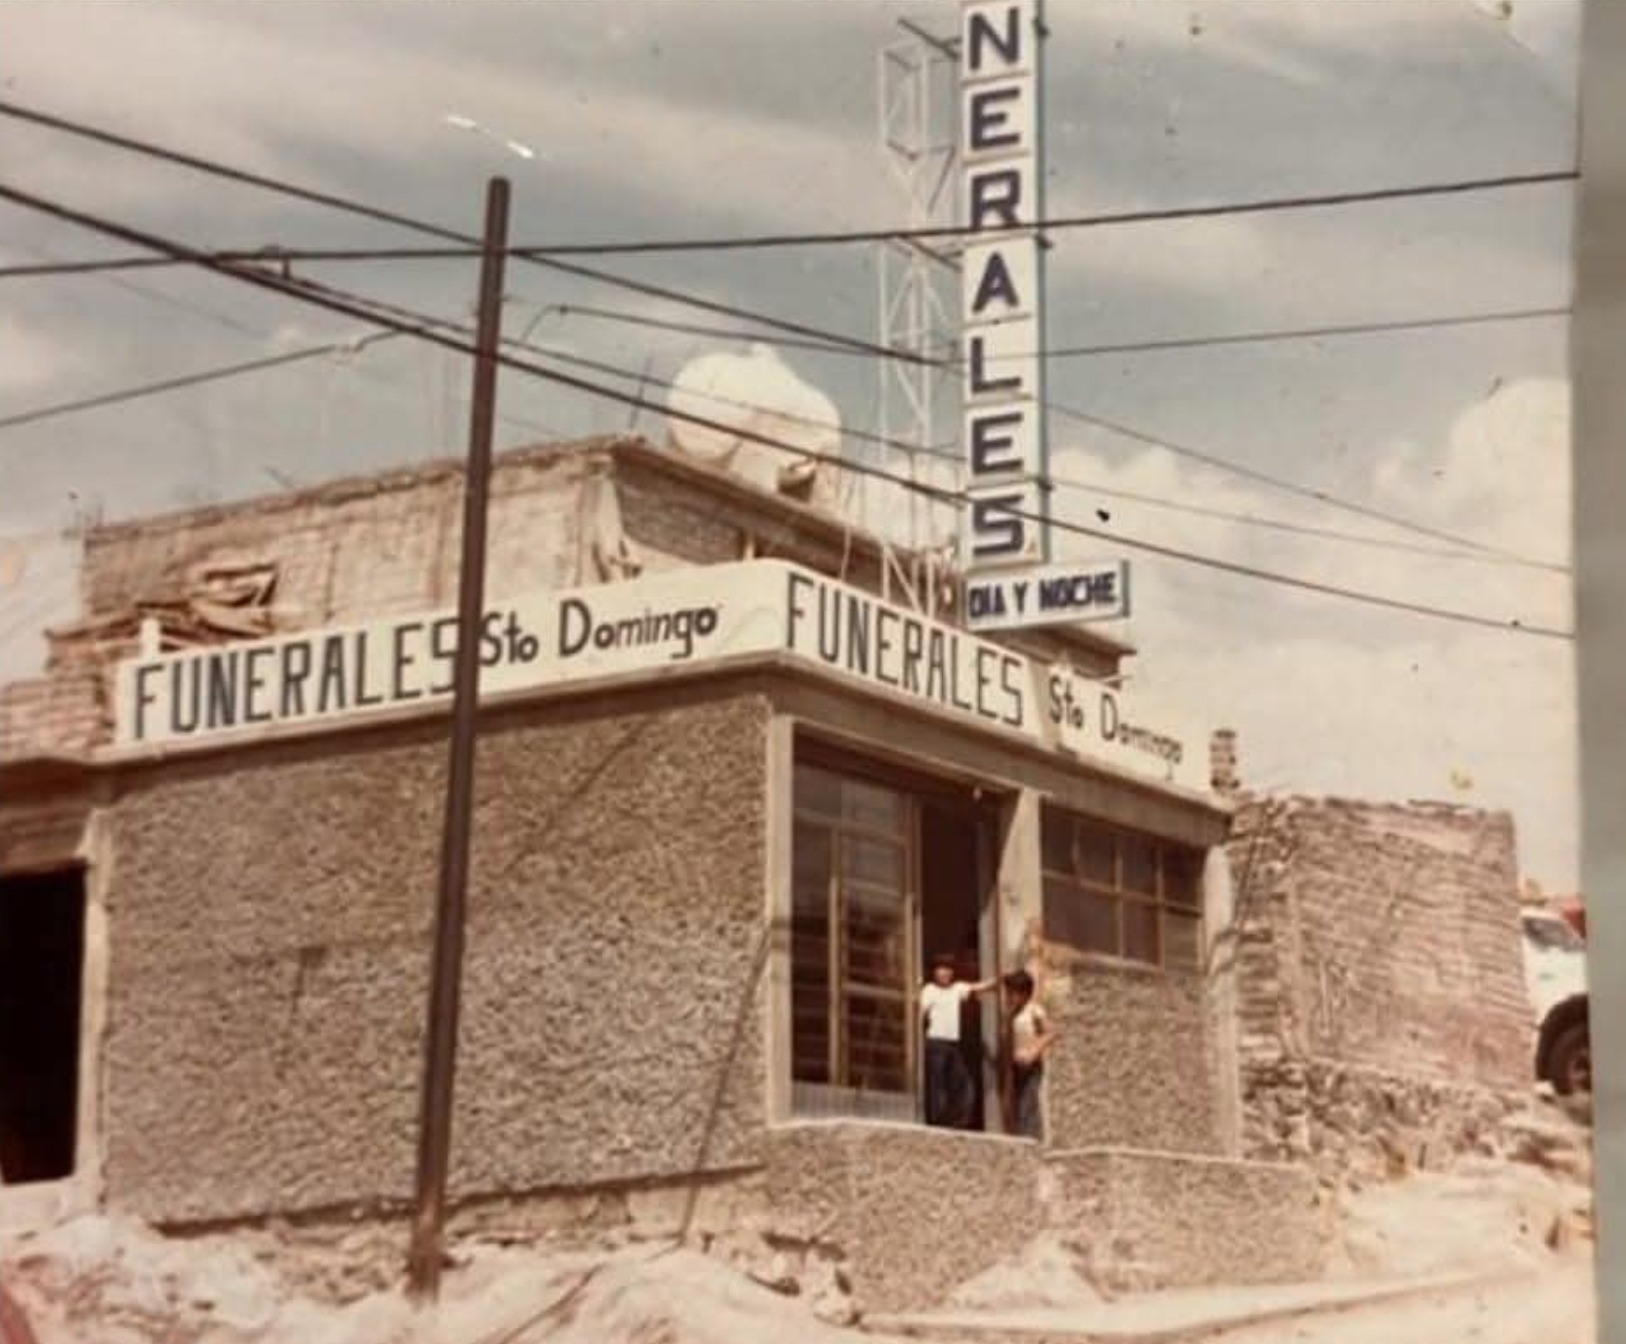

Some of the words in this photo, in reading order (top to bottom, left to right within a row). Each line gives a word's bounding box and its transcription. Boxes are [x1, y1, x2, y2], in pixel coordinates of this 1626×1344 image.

[968, 584, 1006, 619] DIA
[1013, 582, 1030, 614] Y
[1038, 571, 1117, 612] NOCHE
[478, 611, 539, 667] Sto
[559, 598, 719, 660] Domingo
[787, 571, 1023, 727] FUNERALES
[1048, 675, 1084, 729] Sto
[1100, 693, 1184, 780] Domingo
